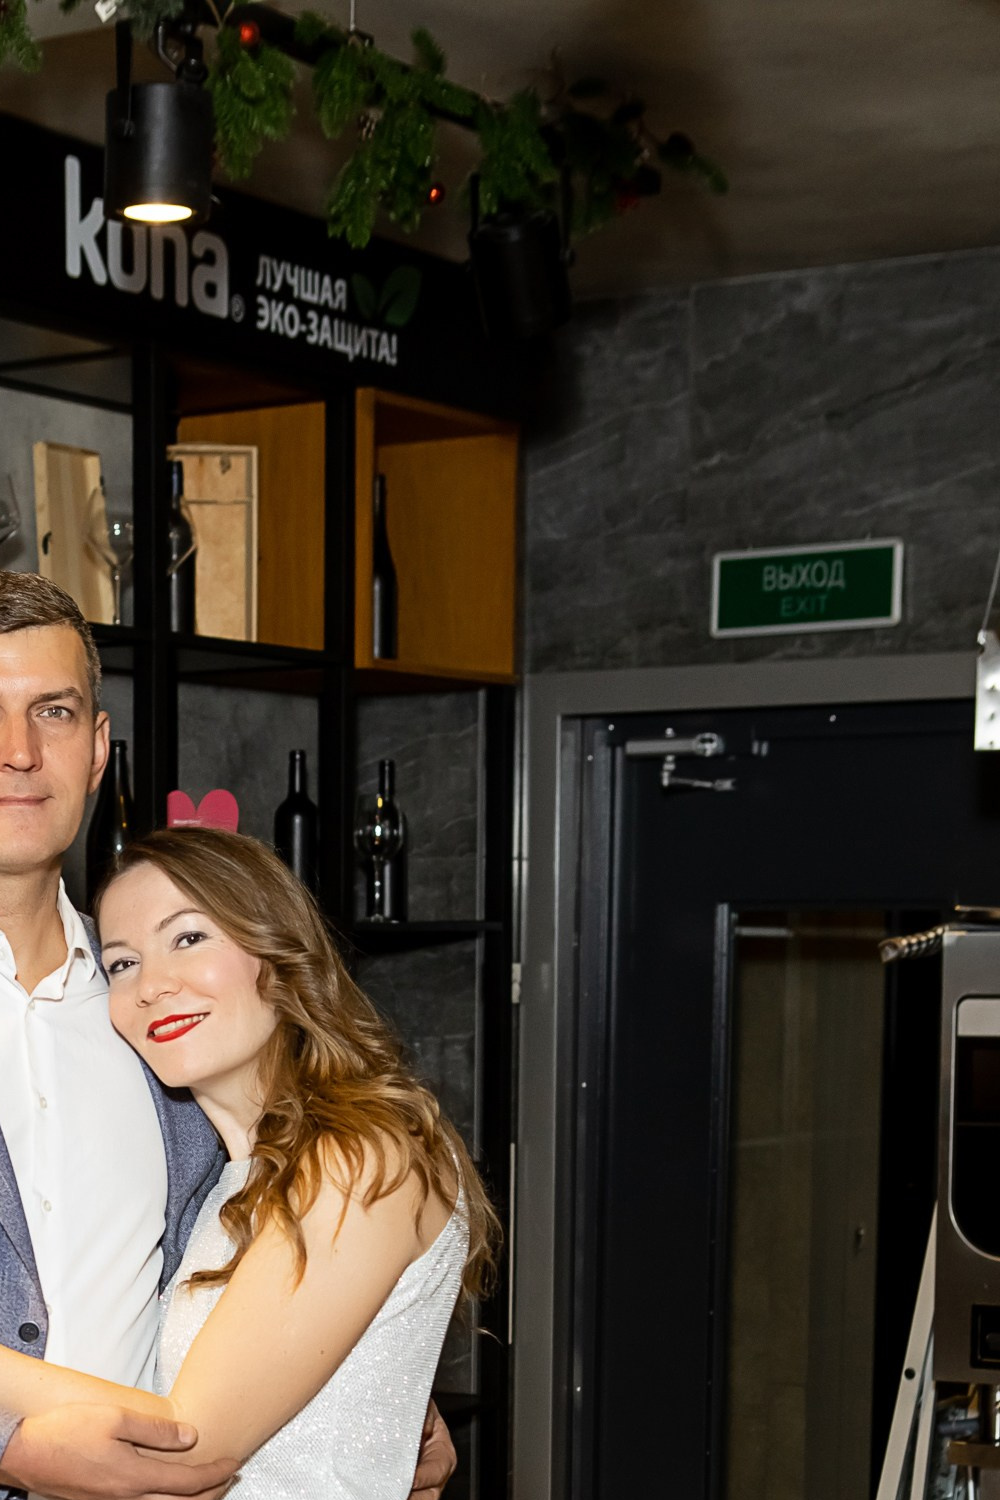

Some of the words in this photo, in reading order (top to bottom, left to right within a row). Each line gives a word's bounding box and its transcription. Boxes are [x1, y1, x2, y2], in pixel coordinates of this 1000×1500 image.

[256, 254, 348, 312] ЛУЧШАЯ
[256, 295, 398, 367] ЭКО-ЗАЩИТА!
[762, 559, 846, 592] ВЫХОД
[780, 593, 829, 617] EXIT
